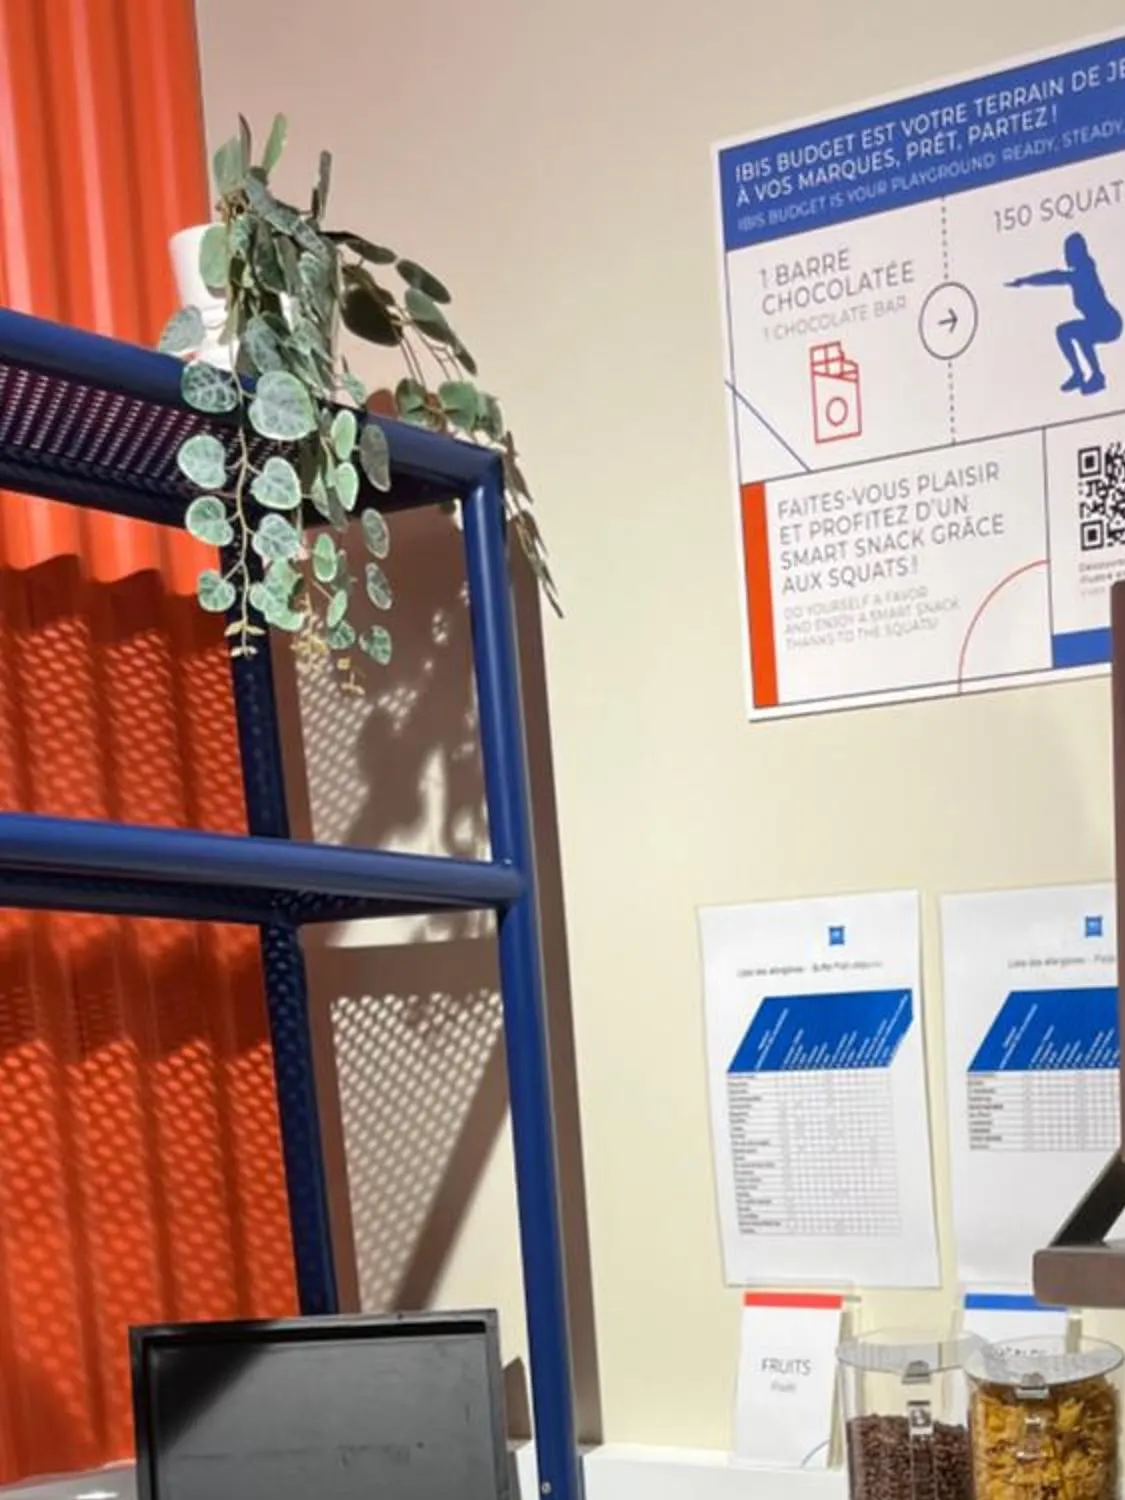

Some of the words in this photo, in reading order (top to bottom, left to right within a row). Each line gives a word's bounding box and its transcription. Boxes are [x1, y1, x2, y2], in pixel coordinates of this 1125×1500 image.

[735, 156, 773, 184] IBIS
[776, 132, 857, 173] BUDGET
[861, 121, 897, 149] EST
[901, 101, 969, 138] VOTRE
[974, 75, 1065, 118] TERRAIN
[1071, 64, 1101, 92] DE
[735, 183, 751, 208] À
[755, 174, 793, 201] VOS
[798, 148, 901, 190] MARQUES,
[906, 130, 963, 161] PRÊT,
[738, 210, 766, 231] IBIS
[768, 196, 826, 224] BUDGET
[829, 190, 845, 208] IS
[847, 177, 888, 205] YOUR
[993, 203, 1033, 232] 150
[761, 258, 915, 316] CHOCOLATÉE
[775, 248, 851, 287] BARRE
[774, 303, 869, 340] CHOCOLATE
[873, 294, 907, 318] BAR
[776, 476, 911, 520] FAITES-VOUS
[917, 461, 1000, 493] PLAISIR
[779, 522, 803, 545] ET
[809, 504, 910, 540] PROFITEZ
[915, 494, 969, 523] D'UN
[780, 540, 849, 571] SMART
[854, 527, 926, 558] SNACK
[930, 513, 1006, 545] GRÂCE
[781, 571, 823, 596] AUX
[761, 1356, 812, 1377] FRUITS
